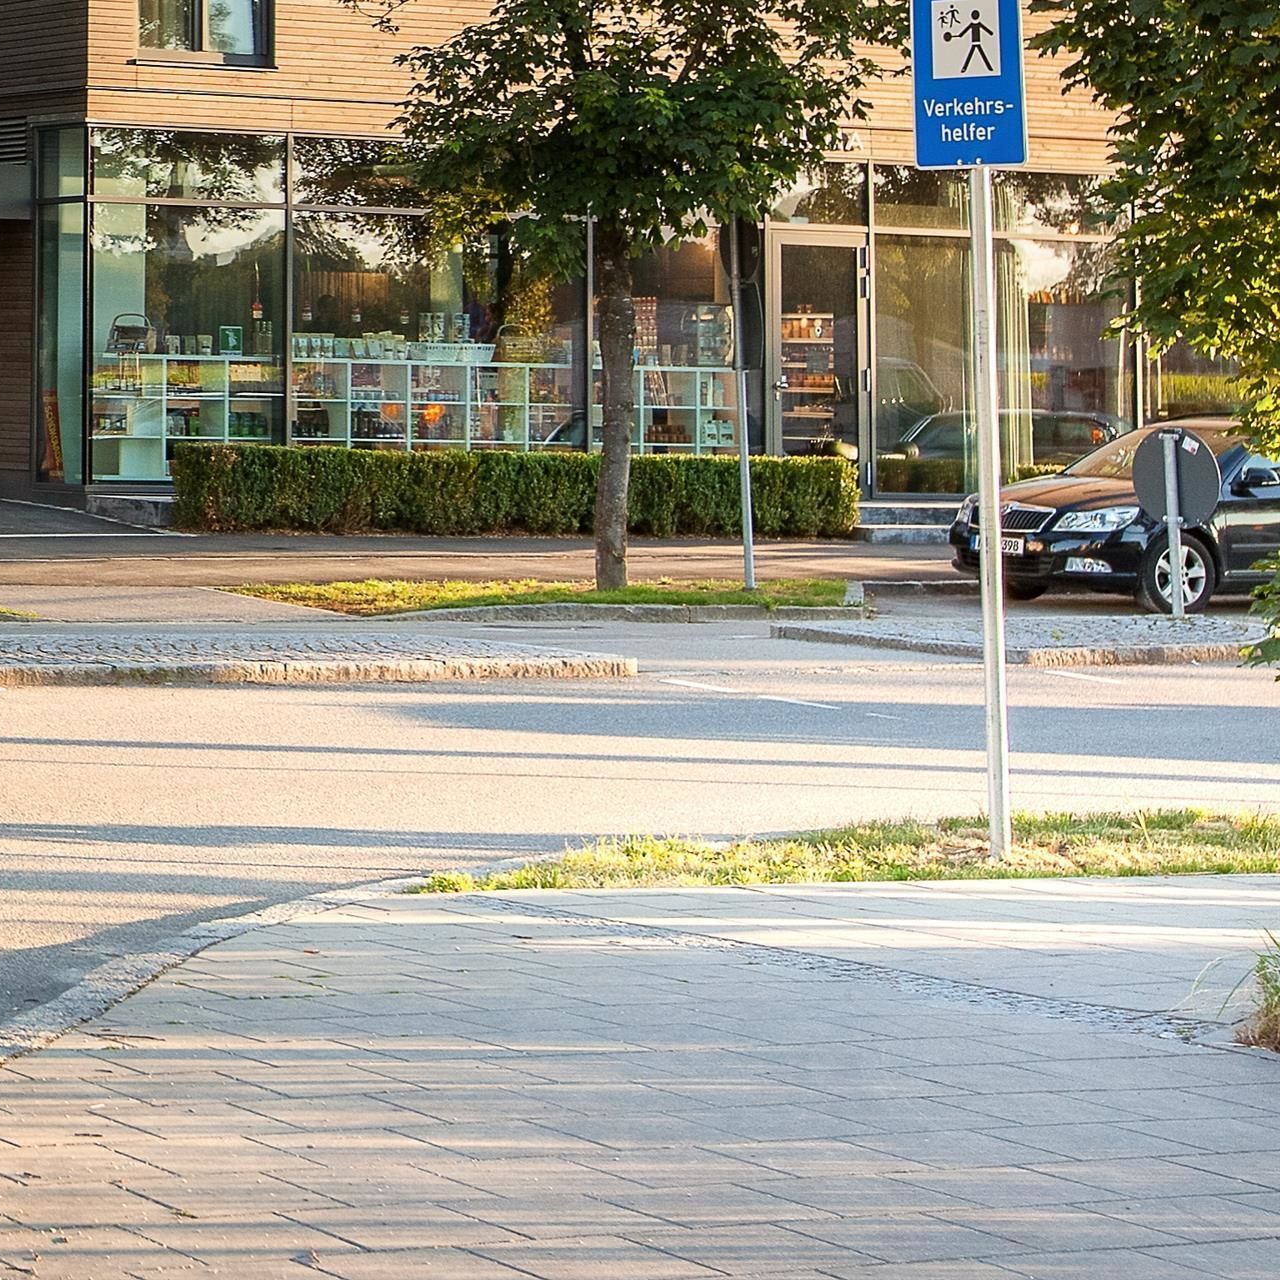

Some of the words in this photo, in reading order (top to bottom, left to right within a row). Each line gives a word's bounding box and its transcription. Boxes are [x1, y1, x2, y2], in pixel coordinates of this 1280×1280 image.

[922, 96, 1014, 118] Verkehrs-
[941, 122, 996, 142] helfer
[1002, 539, 1019, 552] 398
